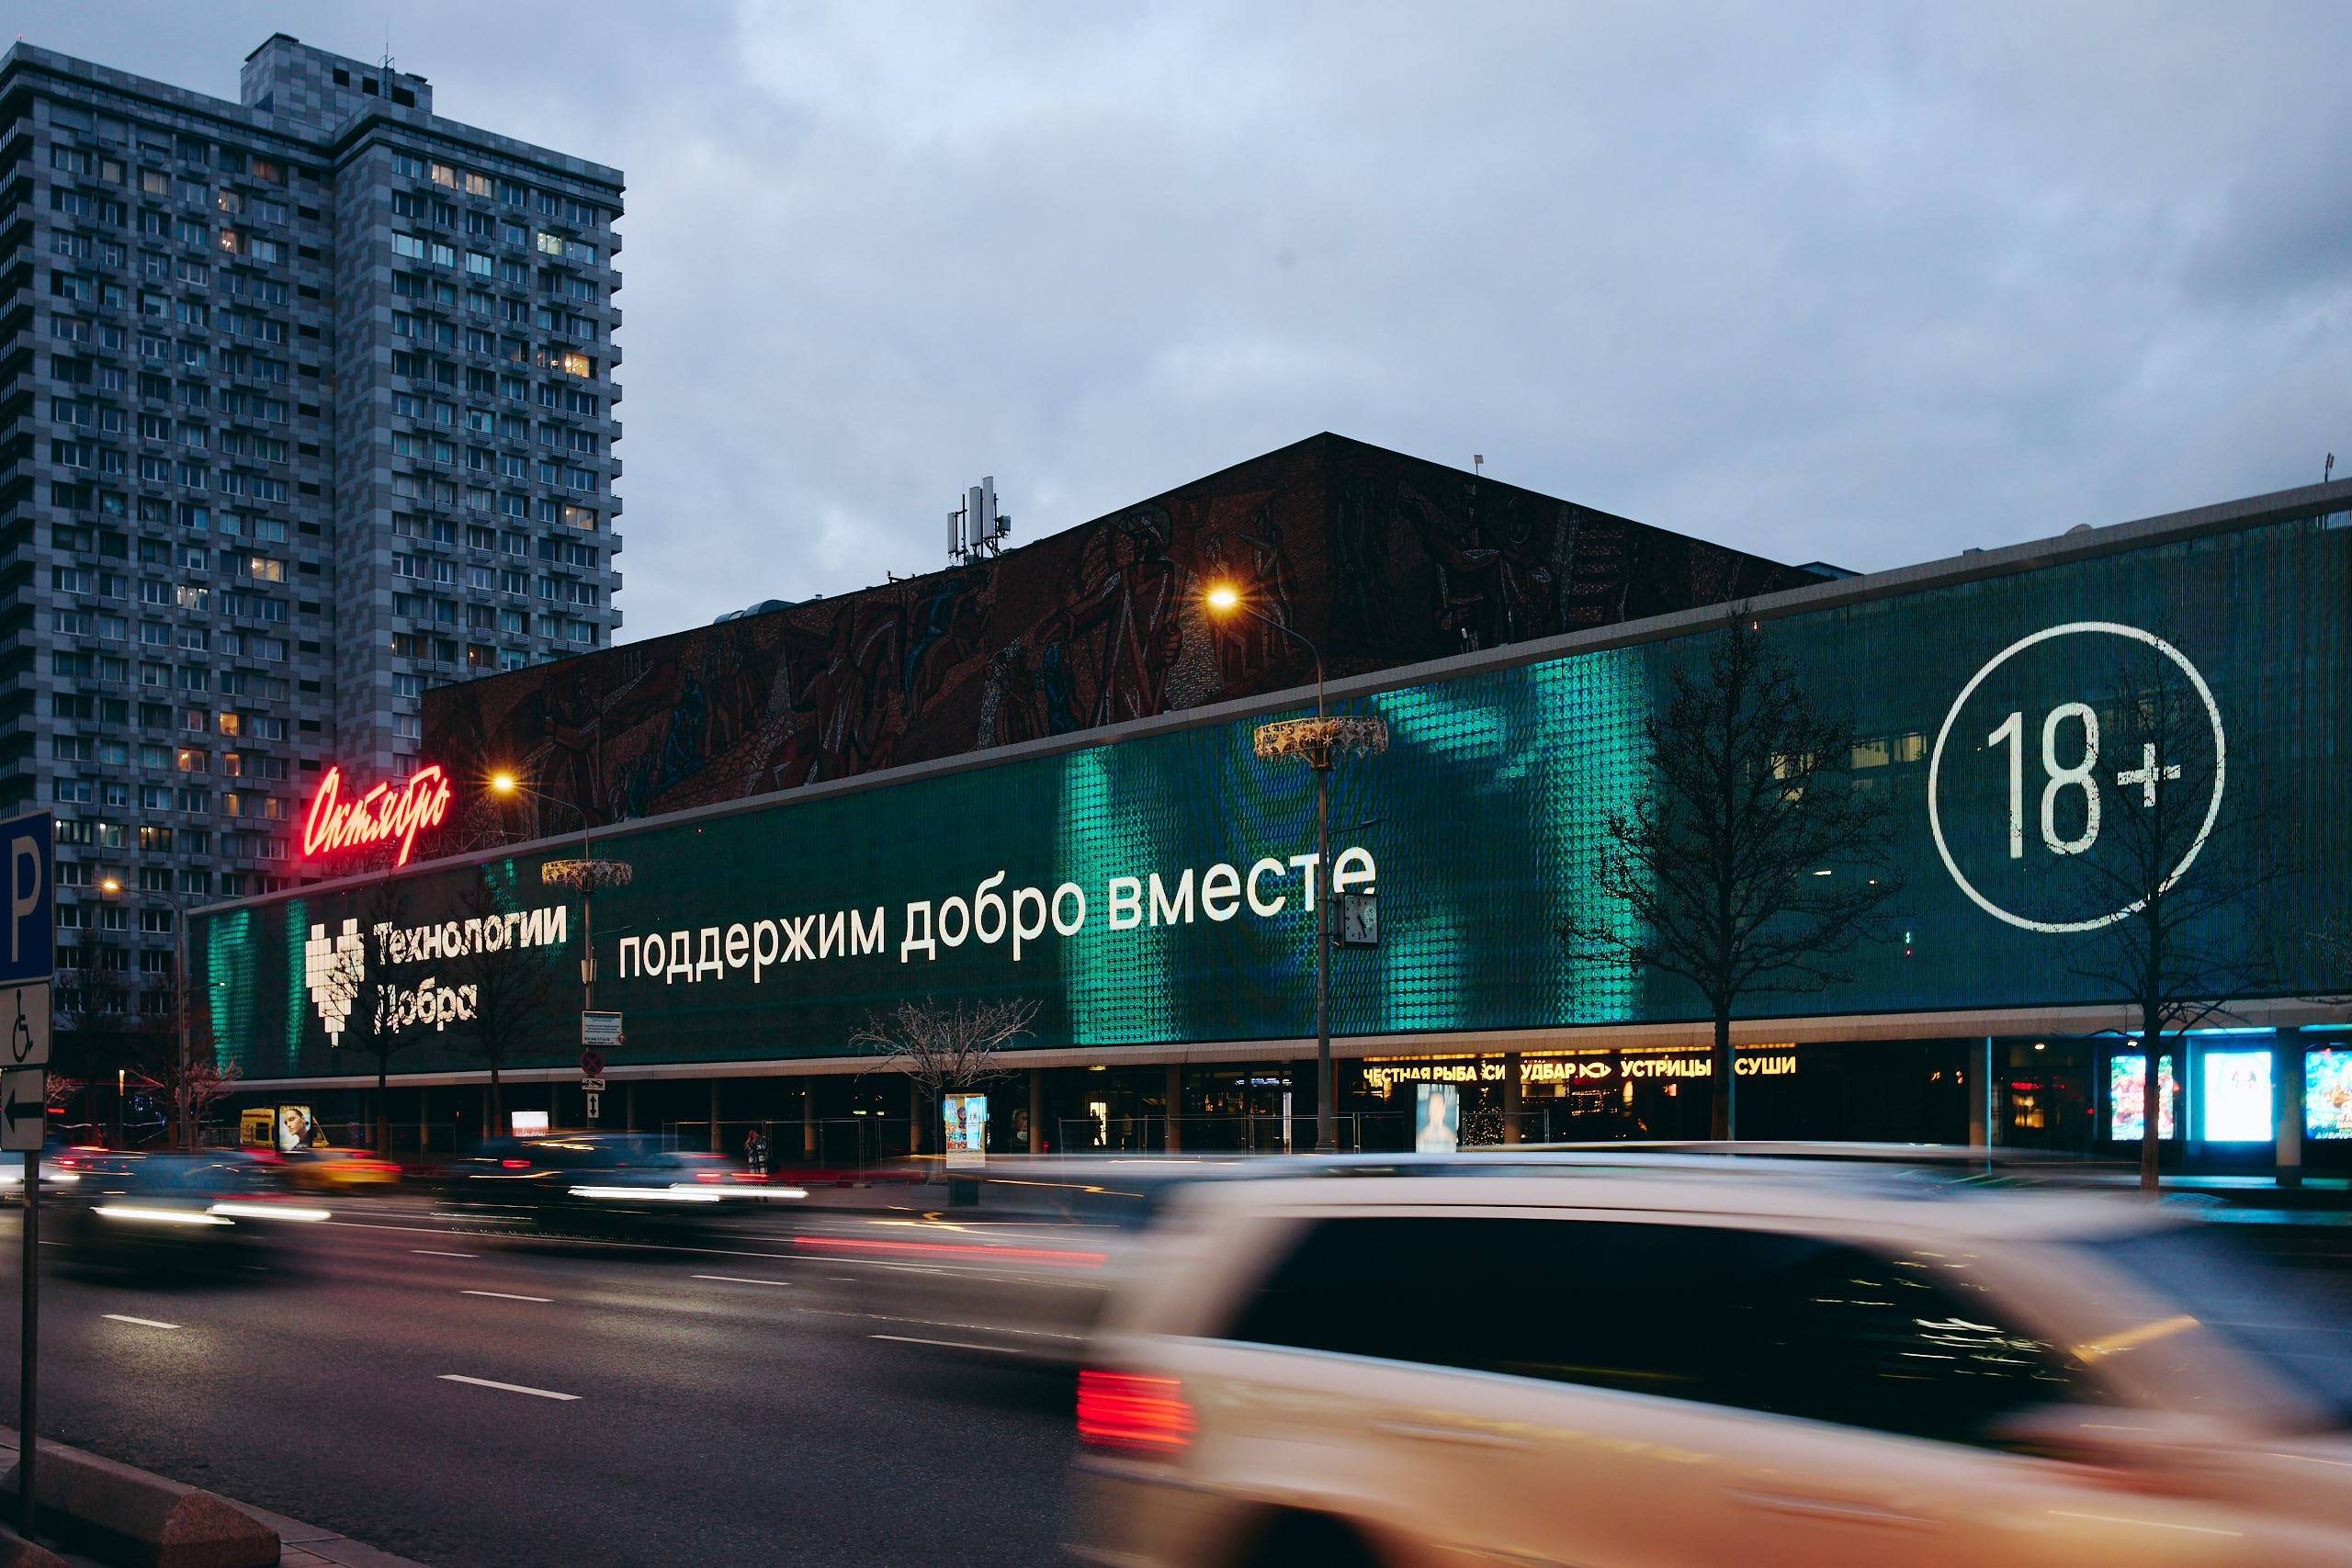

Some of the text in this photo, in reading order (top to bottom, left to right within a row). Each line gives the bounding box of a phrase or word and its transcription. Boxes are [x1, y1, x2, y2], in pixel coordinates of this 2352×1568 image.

[303, 764, 451, 867] Октябрь
[1988, 702, 2181, 859] 18+
[11, 835, 42, 963] P
[373, 905, 567, 965] Технологии
[619, 845, 1377, 985] поддержим добро вместе
[1363, 1066, 1430, 1084] ЧЕСТНАЯ
[1433, 1065, 1477, 1081] РЫБА
[1621, 1059, 1712, 1077] УСТРИЦЫ
[1734, 1056, 1796, 1076] СУШИ
